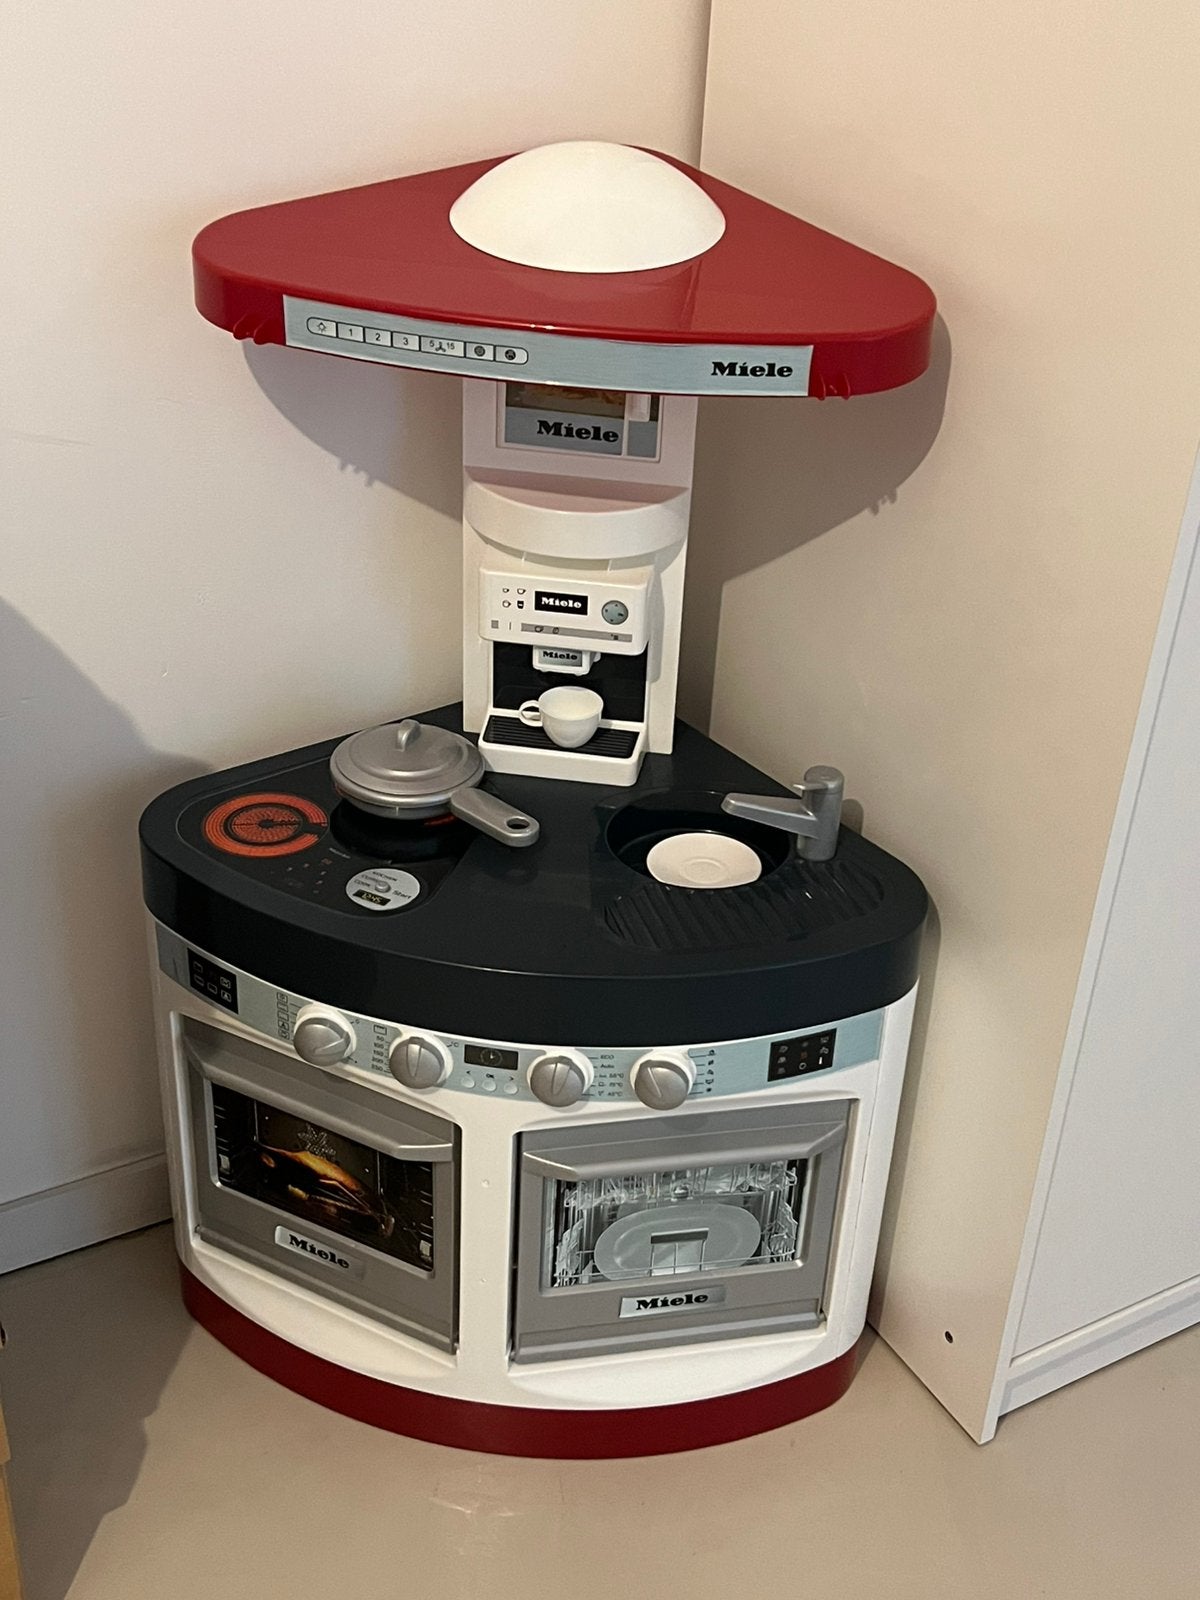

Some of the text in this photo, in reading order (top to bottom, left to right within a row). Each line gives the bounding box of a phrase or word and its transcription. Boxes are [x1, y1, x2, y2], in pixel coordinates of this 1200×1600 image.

[375, 332, 381, 342] 2
[402, 336, 409, 346] 3
[446, 343, 455, 351] 15
[711, 361, 794, 378] Miele
[537, 419, 619, 443] Miele
[541, 596, 582, 609] Miele
[542, 650, 578, 661] Miele
[288, 1233, 350, 1270] Miele
[635, 1293, 709, 1311] Miele
